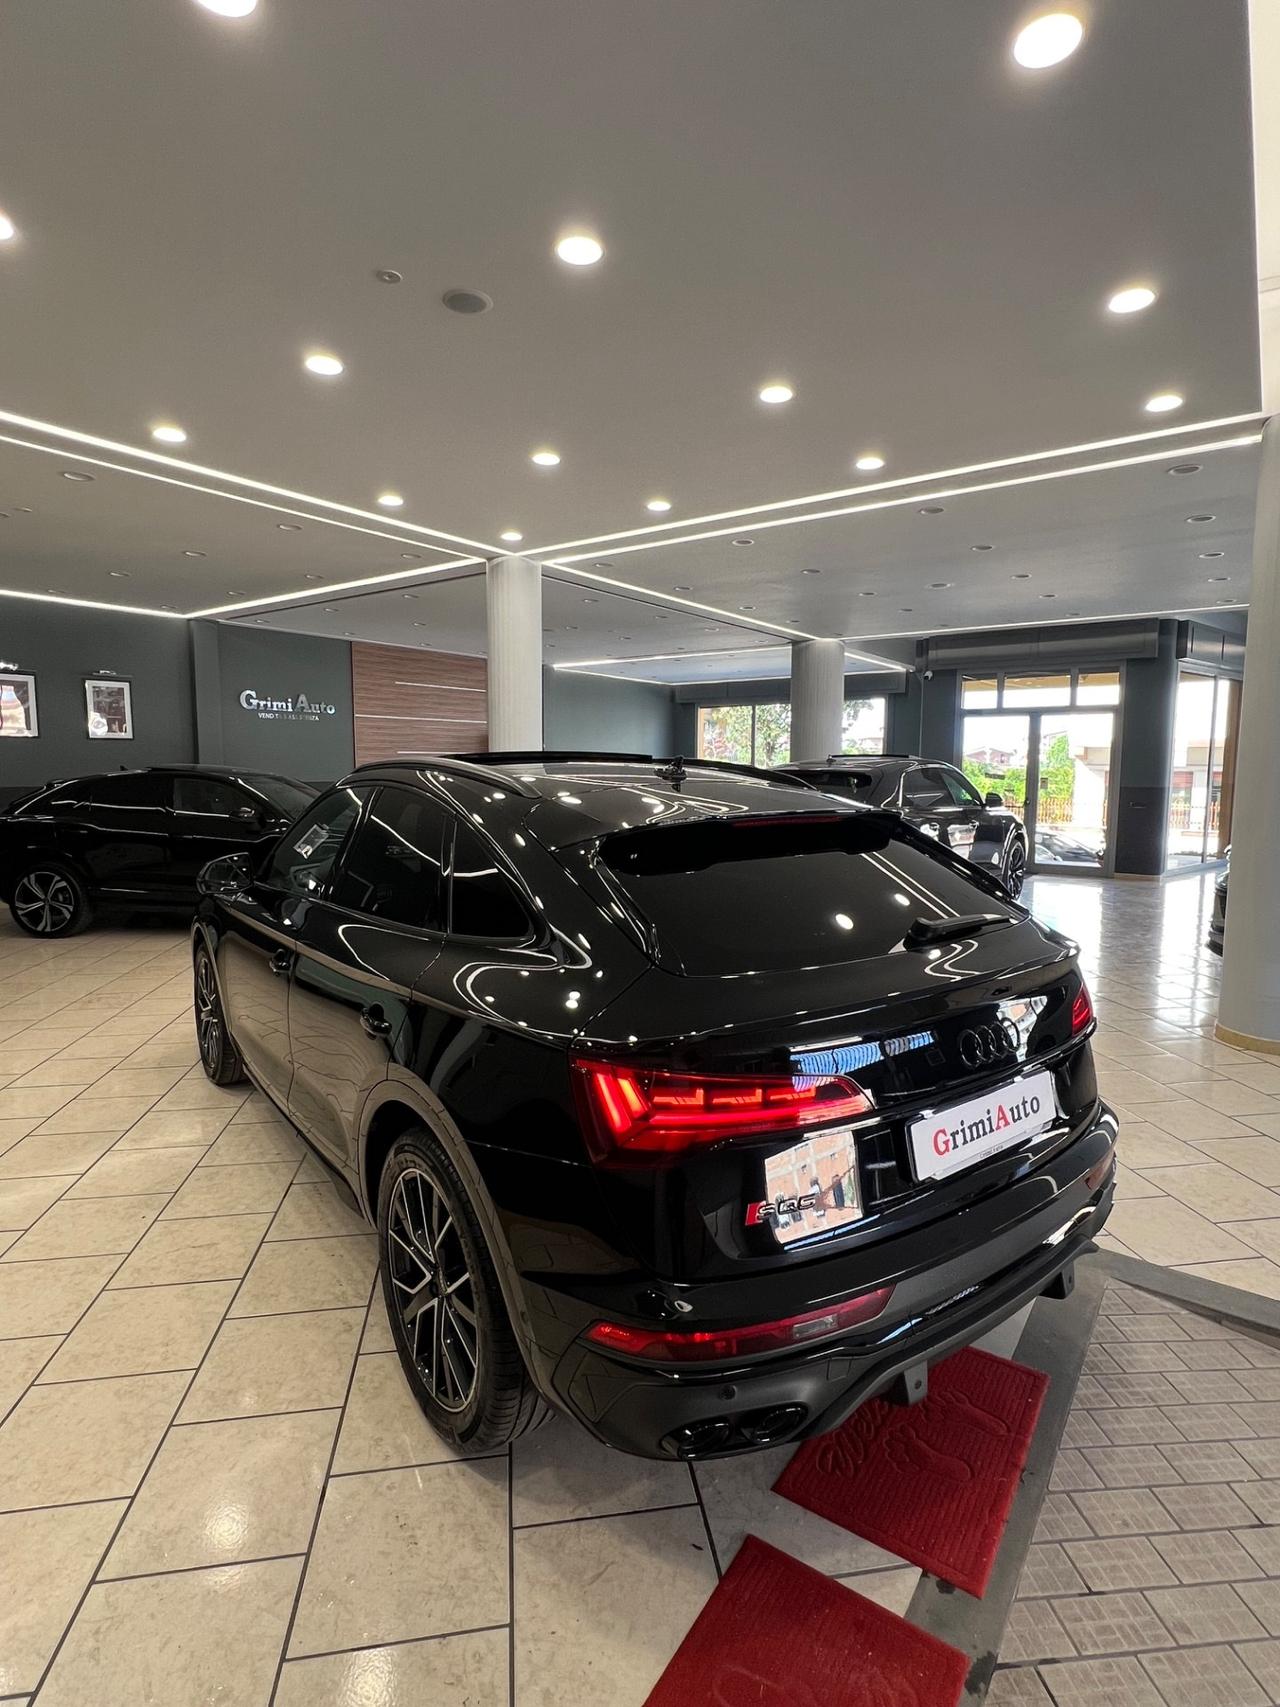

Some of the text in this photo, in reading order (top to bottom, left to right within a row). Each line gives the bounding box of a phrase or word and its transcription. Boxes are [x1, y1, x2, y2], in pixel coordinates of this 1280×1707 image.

[240, 690, 335, 714] Grimi Auto
[933, 1095, 1041, 1156] GrimiAuto
